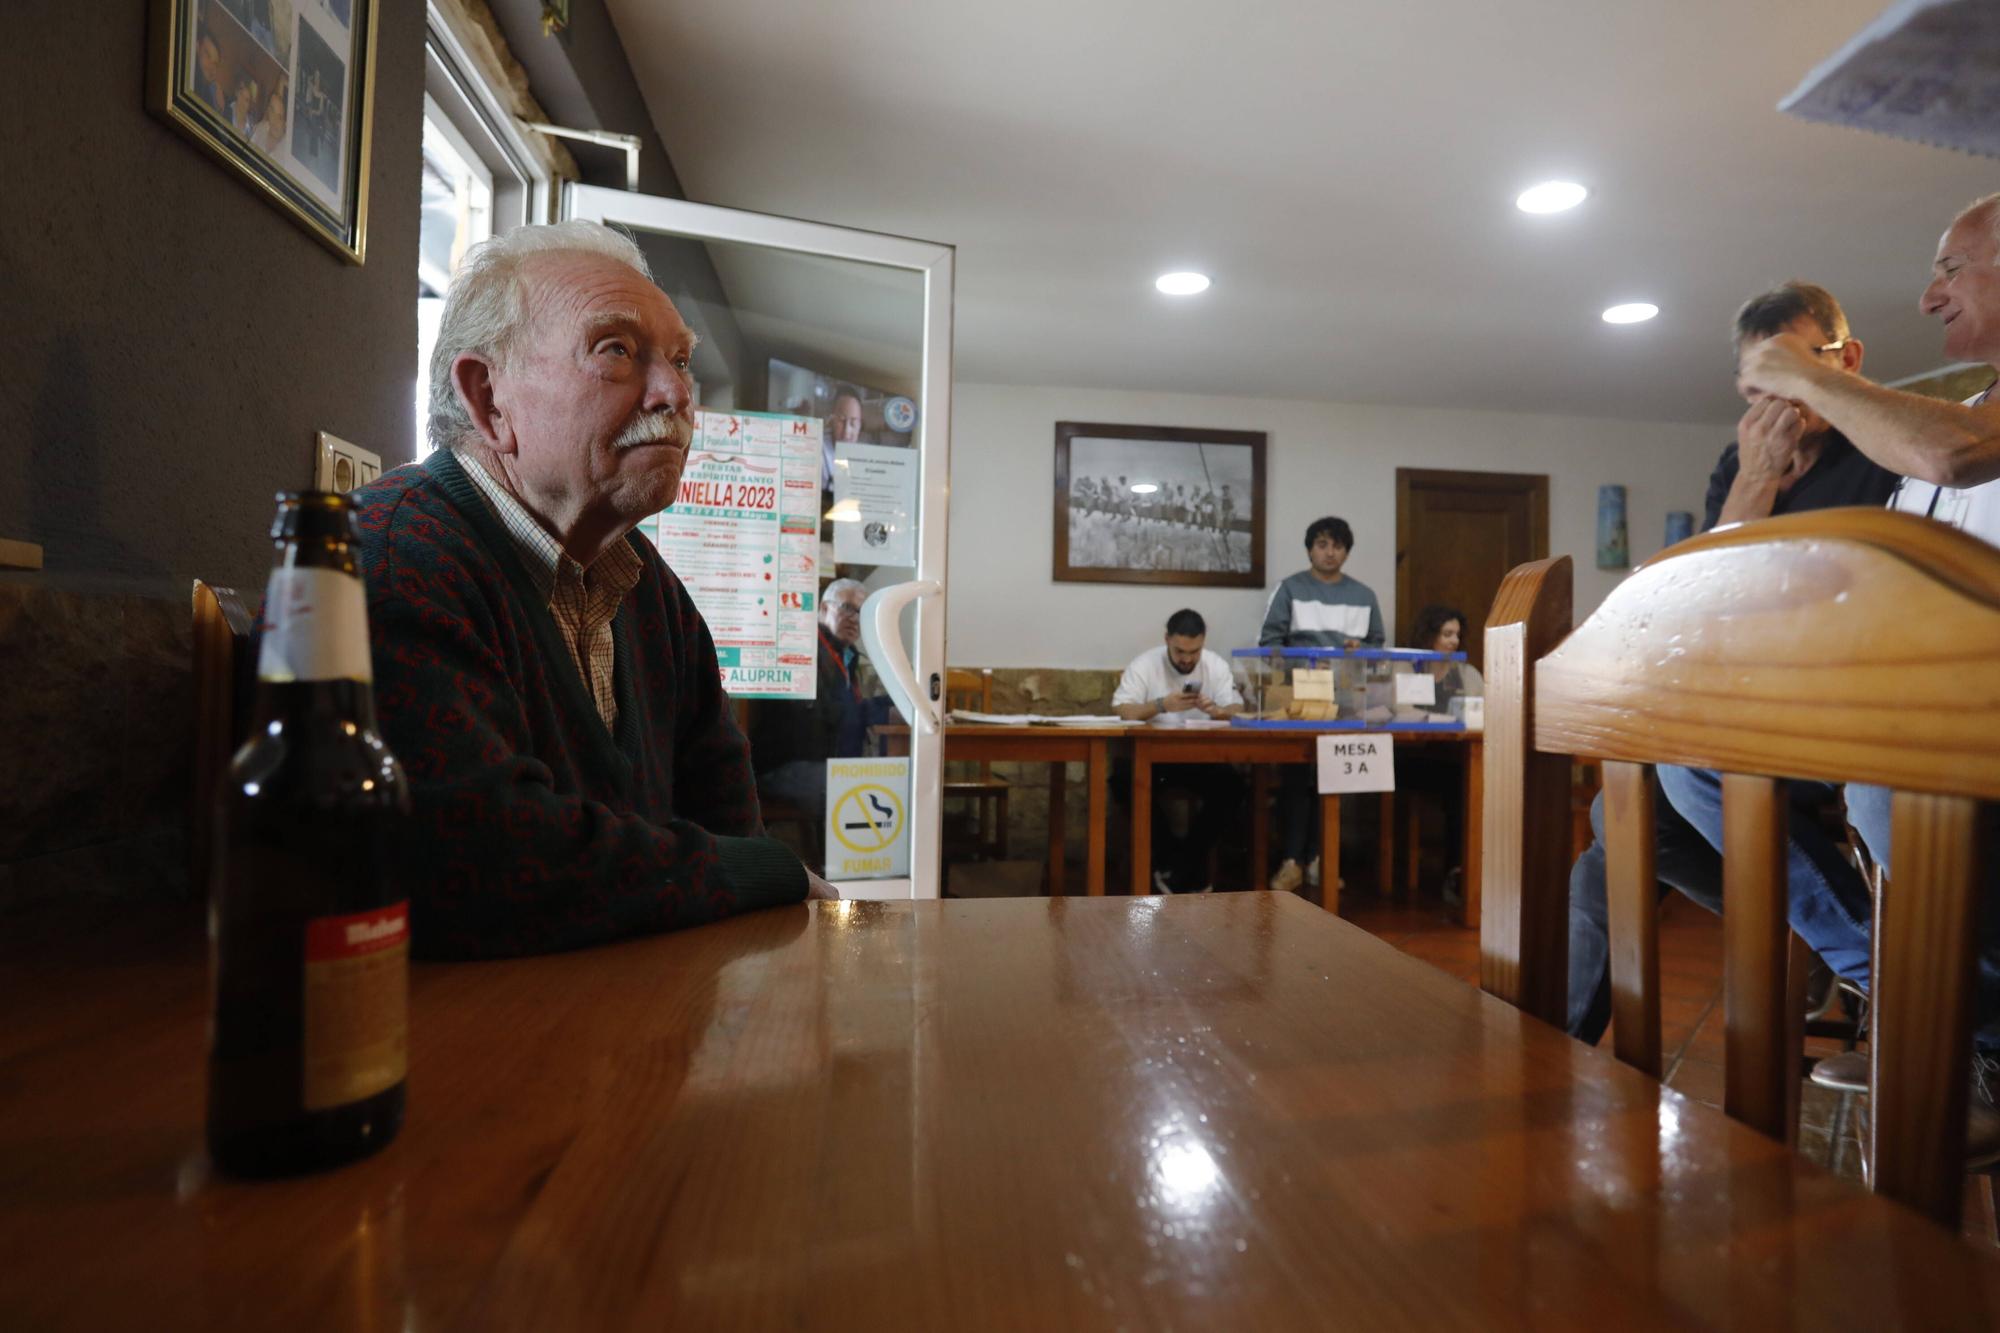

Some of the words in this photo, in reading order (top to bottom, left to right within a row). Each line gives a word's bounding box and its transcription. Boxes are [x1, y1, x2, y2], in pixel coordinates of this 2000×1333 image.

[702, 463, 742, 473] FIESTAS
[690, 472, 737, 483] ESPÍRITU
[740, 476, 774, 484] SANTO
[677, 481, 732, 506] INIELLA
[737, 485, 775, 509] 2023
[730, 669, 792, 683] ALUPRIN
[1334, 743, 1377, 756] MESA
[832, 764, 905, 778] PROHIBIDO
[1344, 762, 1353, 775] 3
[1358, 762, 1368, 774] A
[843, 858, 892, 873] FUMAR
